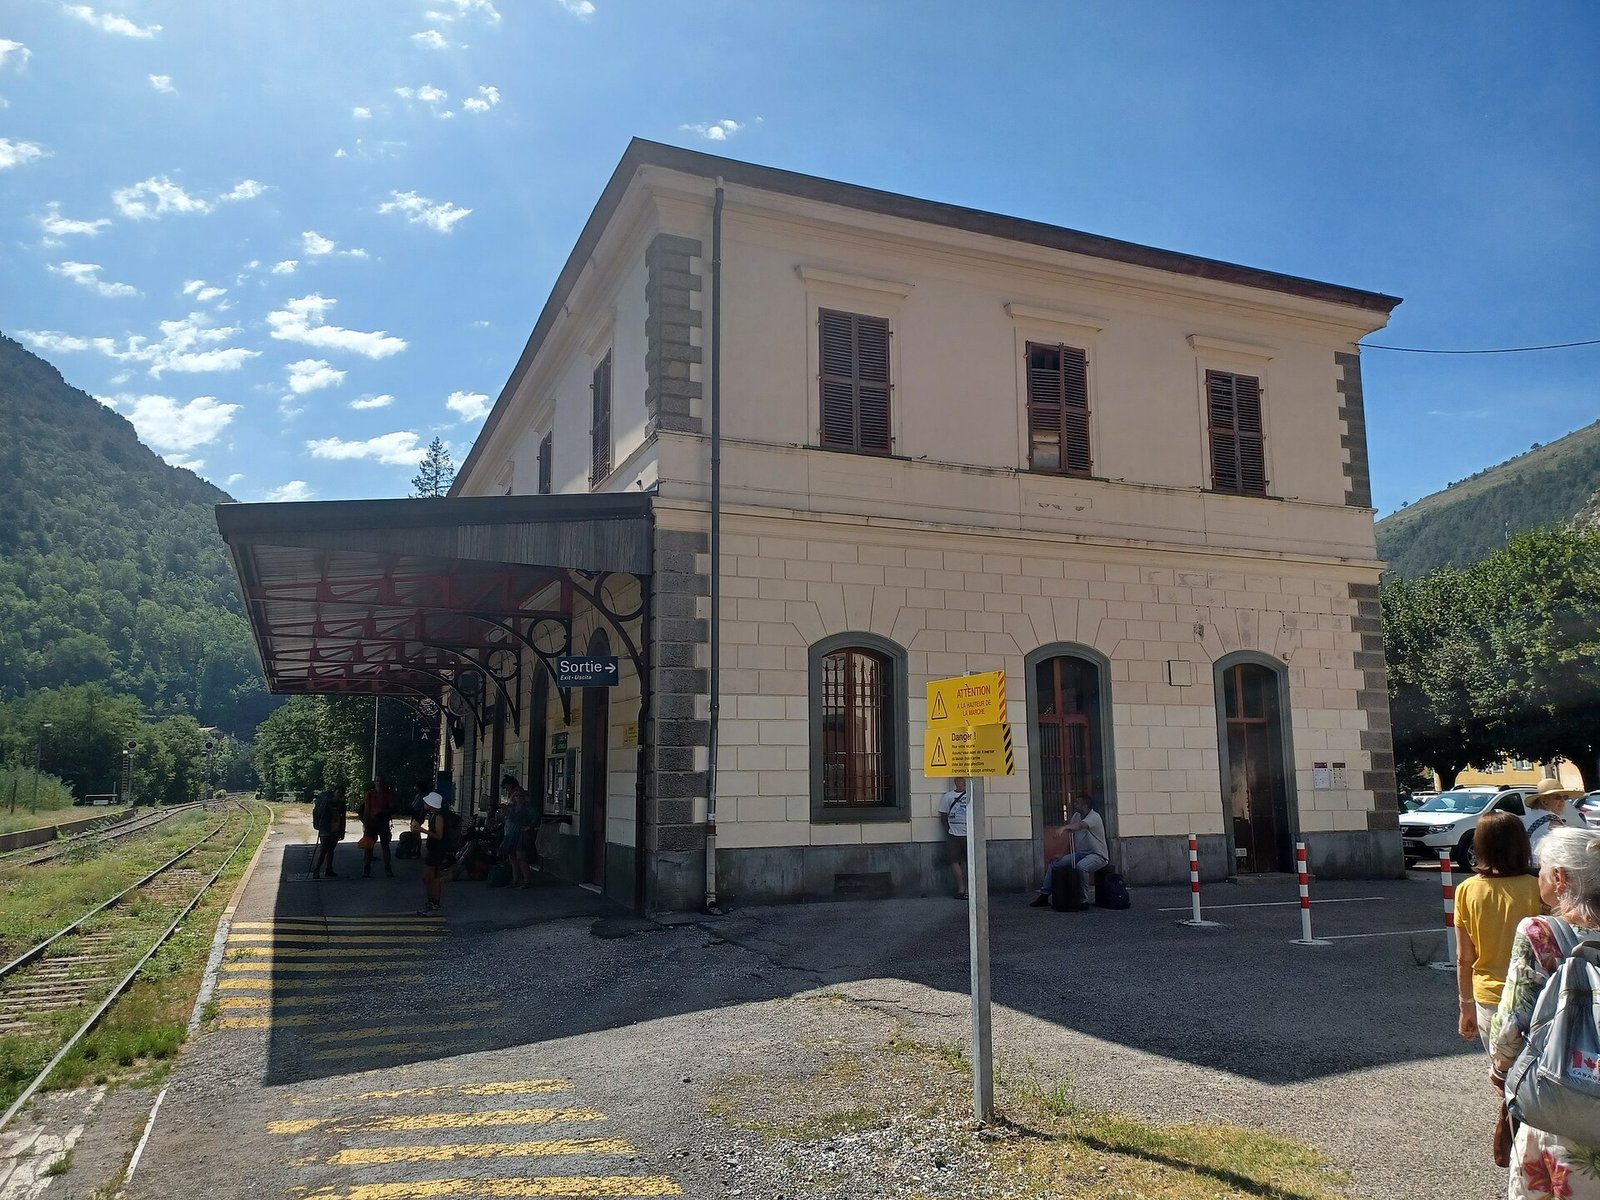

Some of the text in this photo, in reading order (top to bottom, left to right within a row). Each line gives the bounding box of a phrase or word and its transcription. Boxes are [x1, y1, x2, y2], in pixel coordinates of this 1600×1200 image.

[560, 660, 602, 673] Sortie
[957, 685, 991, 698] ATTENTION
[967, 700, 984, 708] HAUTEUR
[969, 708, 985, 716] MARCHE
[421, 732, 429, 740] A
[951, 731, 977, 743] Danger !
